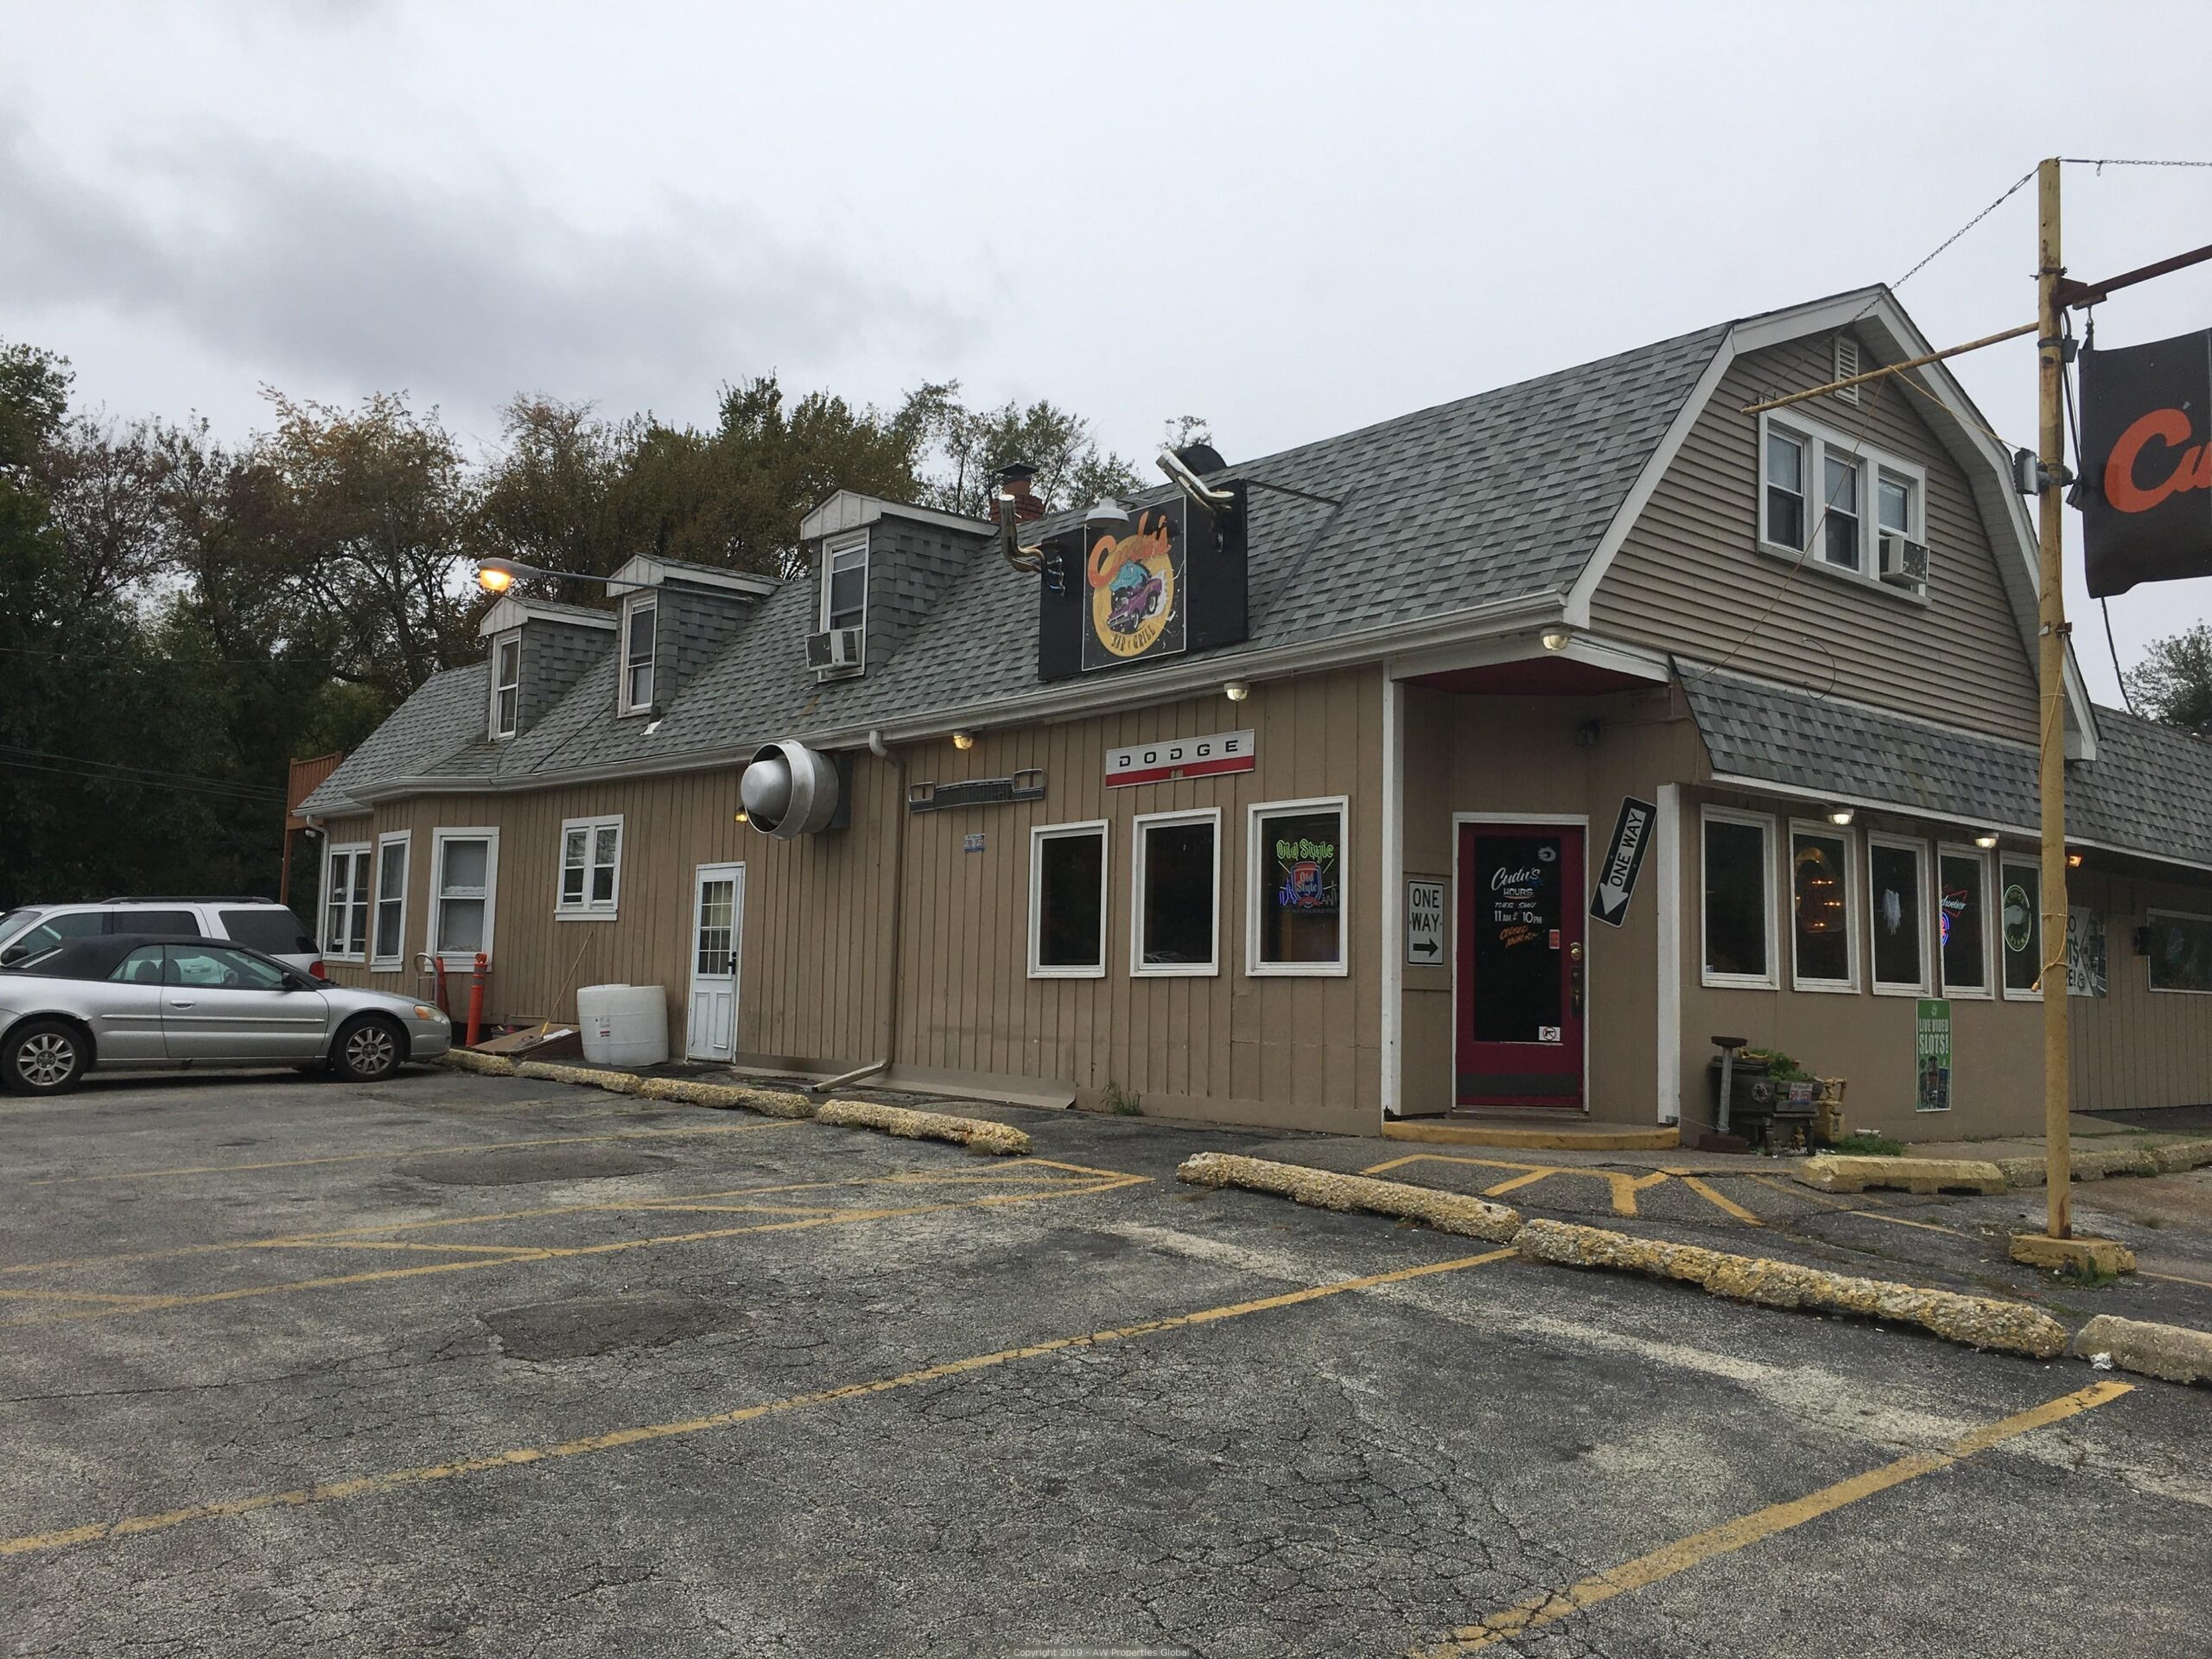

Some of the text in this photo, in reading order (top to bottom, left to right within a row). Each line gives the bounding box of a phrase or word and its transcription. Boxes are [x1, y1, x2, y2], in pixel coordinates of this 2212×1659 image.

[1111, 633, 1126, 652] BAR
[1133, 625, 1156, 649] GRILL
[1119, 740, 1238, 767] DODGE
[1276, 838, 1334, 863] Old Style
[1611, 811, 1643, 887] ONE WAY
[1296, 880, 1318, 895] Style
[1300, 871, 1314, 882] Old
[1413, 887, 1440, 909] ONE
[1412, 912, 1440, 932] WAY
[1919, 1019, 1949, 1032] LIVE VIDEO
